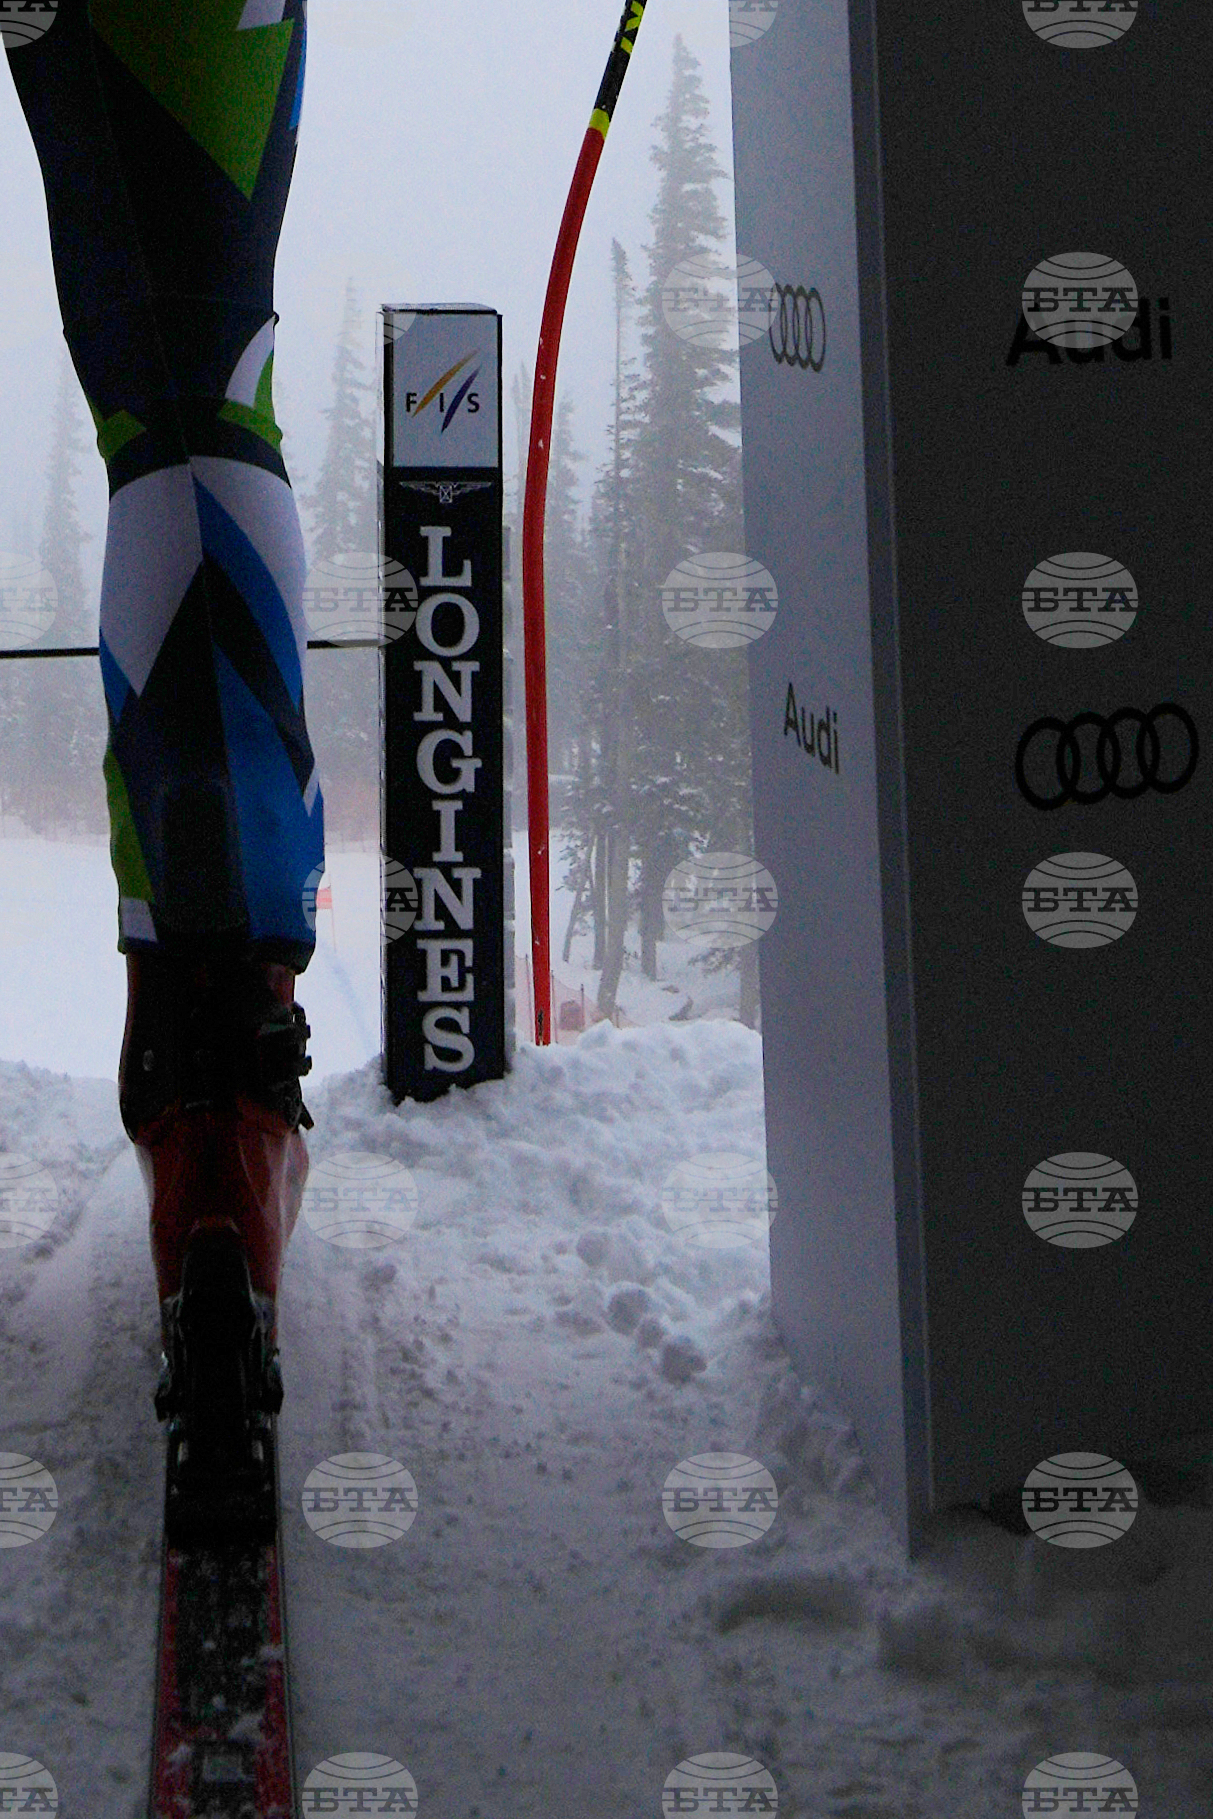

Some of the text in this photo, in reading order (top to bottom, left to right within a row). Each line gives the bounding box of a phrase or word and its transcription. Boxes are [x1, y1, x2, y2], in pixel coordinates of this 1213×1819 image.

[1006, 297, 1173, 366] Audi
[784, 682, 839, 775] Audi
[413, 526, 483, 1073] LONGINES
